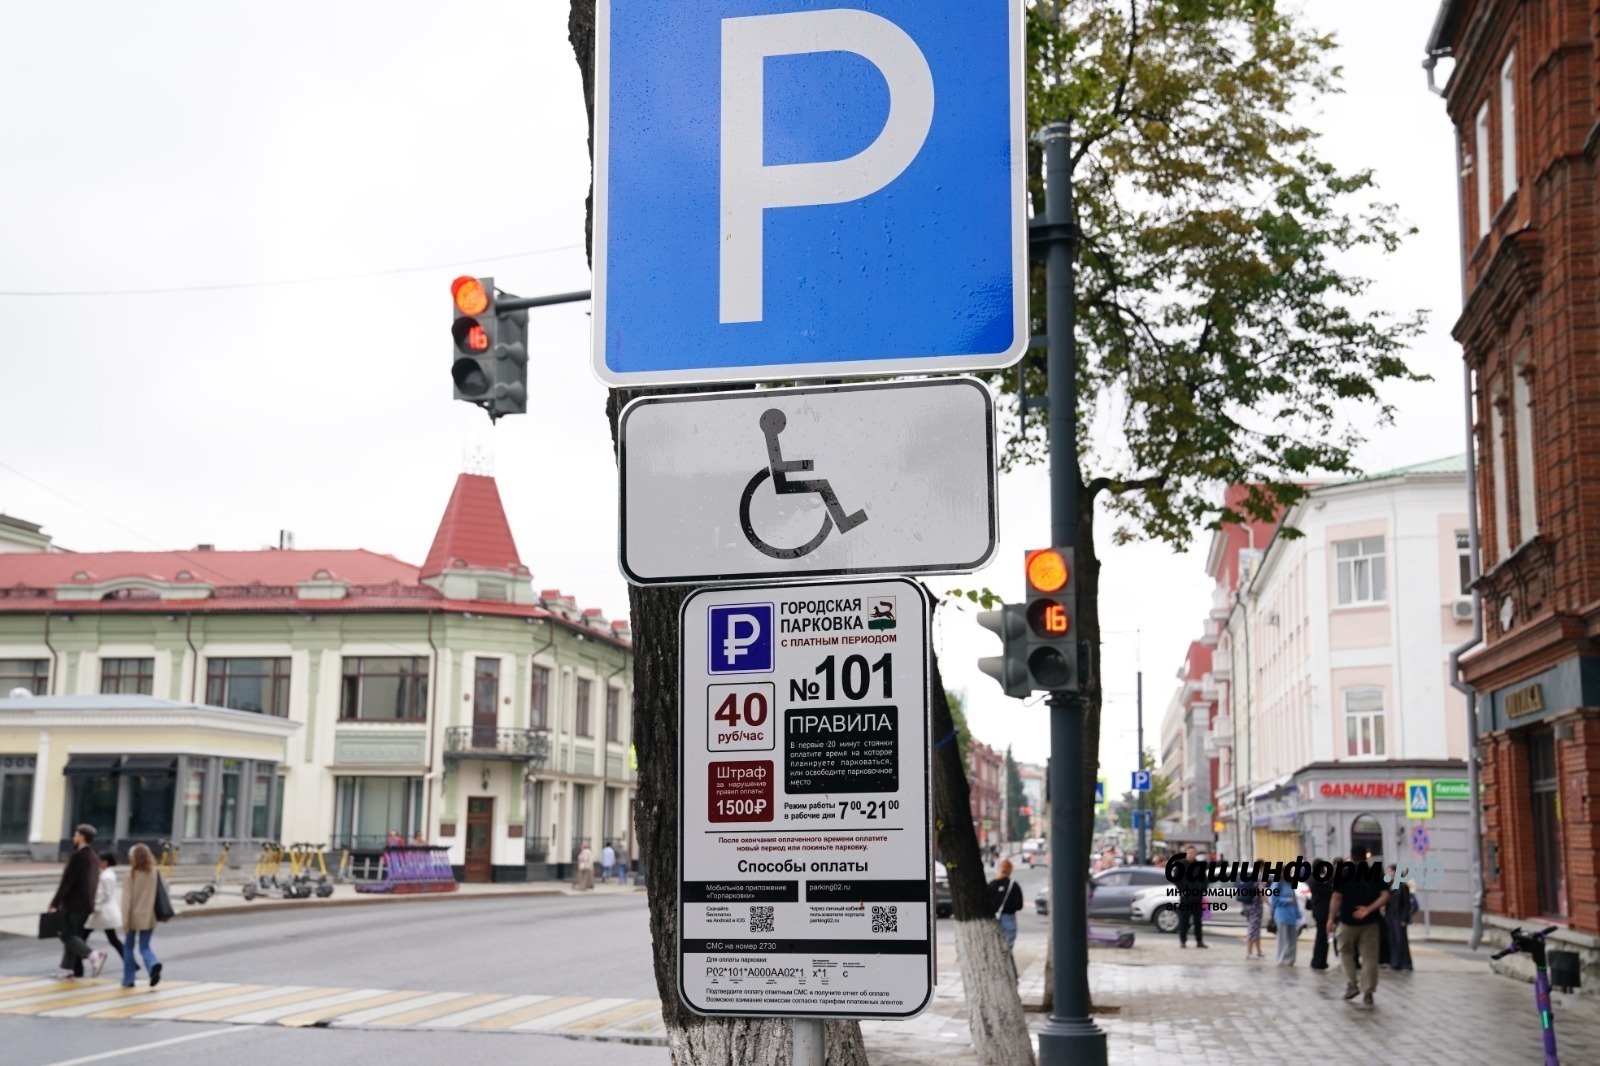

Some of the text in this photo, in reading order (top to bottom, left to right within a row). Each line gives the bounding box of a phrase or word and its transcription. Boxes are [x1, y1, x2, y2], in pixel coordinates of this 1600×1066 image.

[719, 9, 935, 324] P
[780, 598, 862, 615] ГОРОДСКАЯ
[780, 616, 864, 633] ПАРКОВКА
[1045, 604, 1068, 632] 16
[781, 634, 897, 647] С ПЛАТНЫМ ПЕРИОДОМ
[714, 692, 768, 727] 40
[790, 714, 892, 734] ПРАВИЛА
[718, 731, 764, 744] руб/час
[717, 766, 766, 780] Штраф
[848, 768, 892, 776] парковочное
[716, 799, 767, 815] 1500₽
[784, 802, 836, 810] Режим работы
[791, 812, 820, 820] рабочие
[738, 859, 868, 873] Способы оплаты
